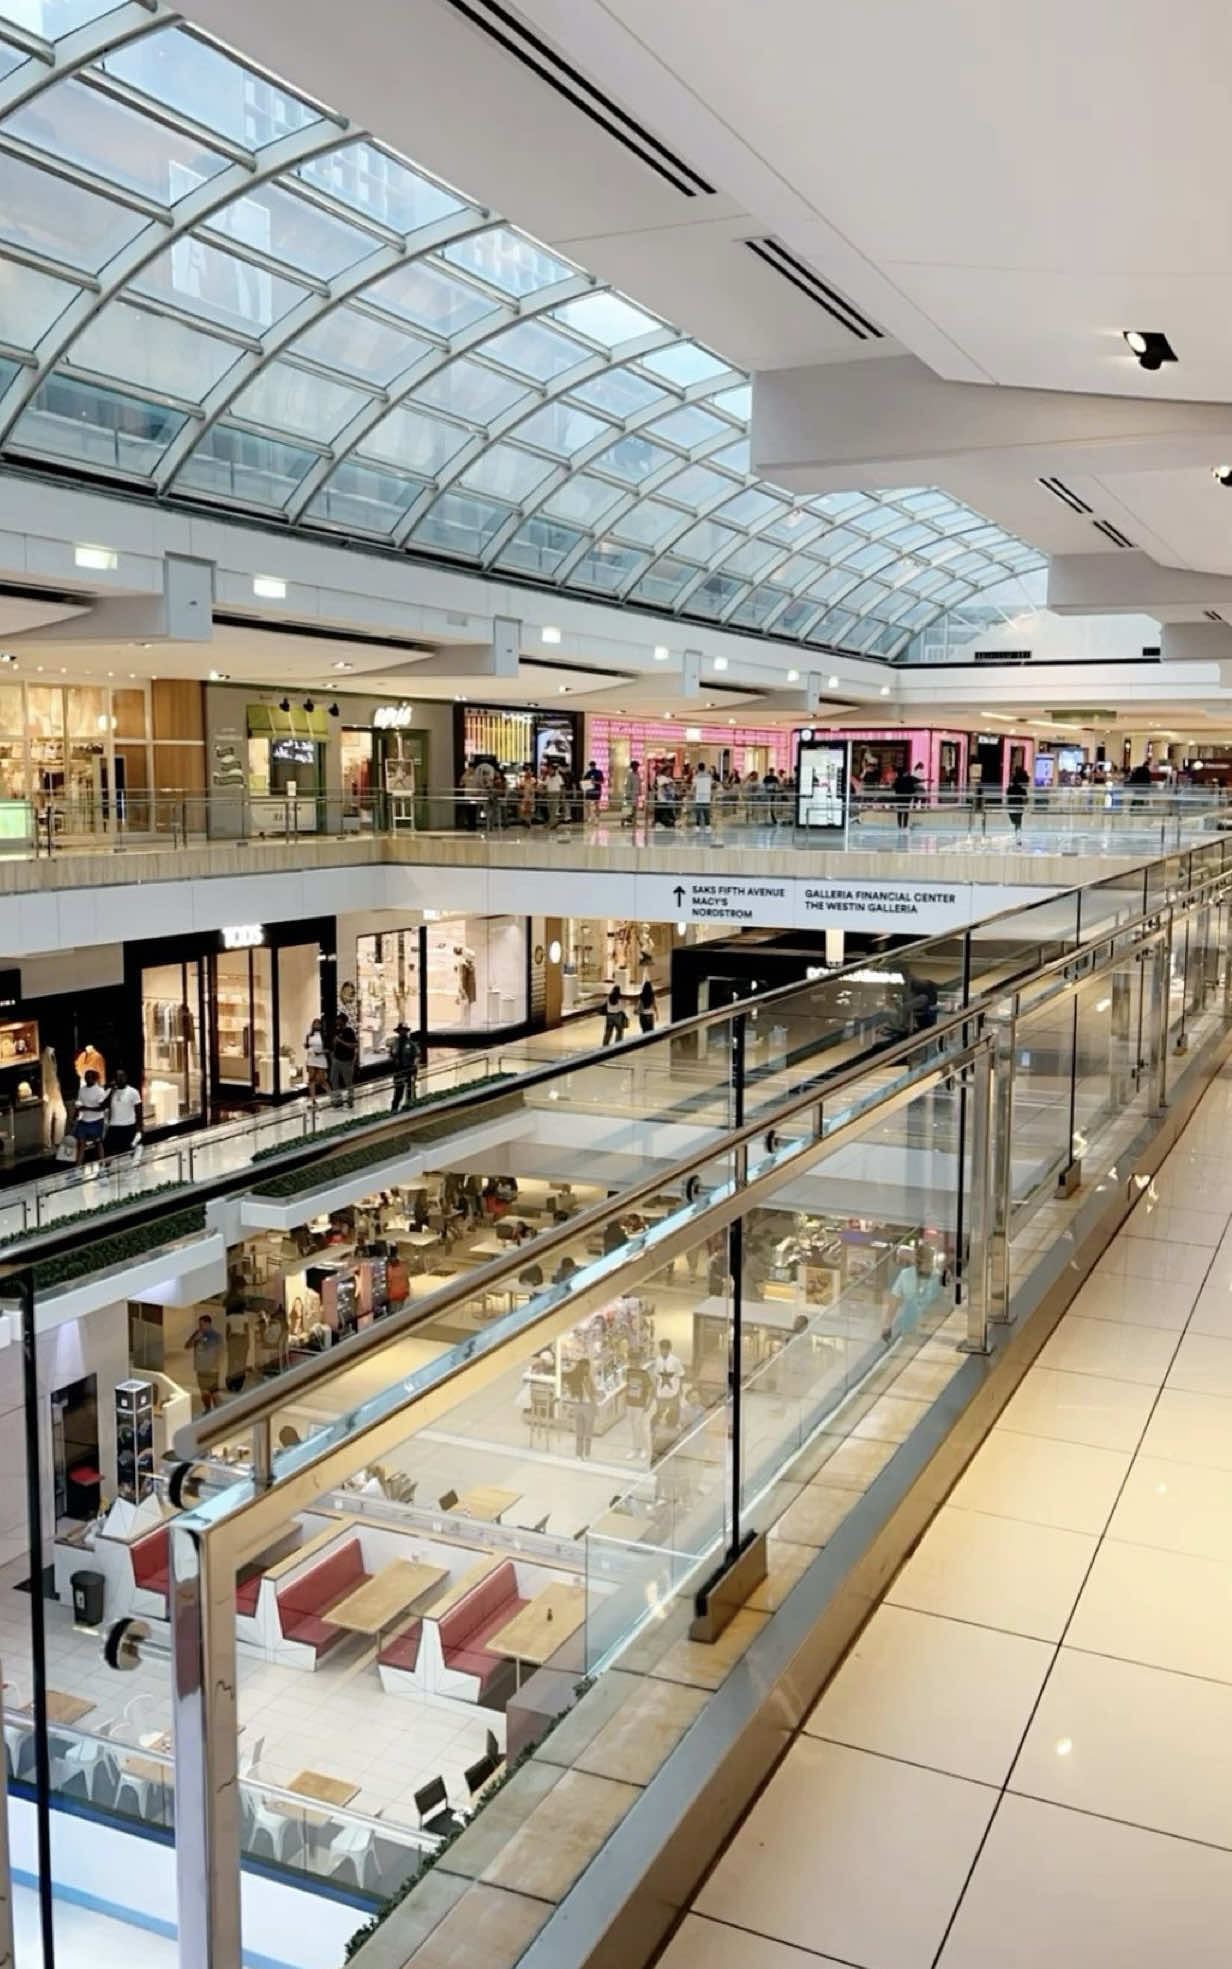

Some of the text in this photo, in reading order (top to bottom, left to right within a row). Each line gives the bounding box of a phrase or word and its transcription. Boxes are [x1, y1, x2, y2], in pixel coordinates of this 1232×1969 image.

[692, 885, 785, 898] SAKS FIFTH AVENUE
[805, 889, 956, 904] GALLERIA FINANCIAL CENTER
[692, 897, 728, 906] MACY'S
[805, 901, 918, 914] THE WESTIN GALLERIA
[692, 908, 752, 919] NORDSTROM
